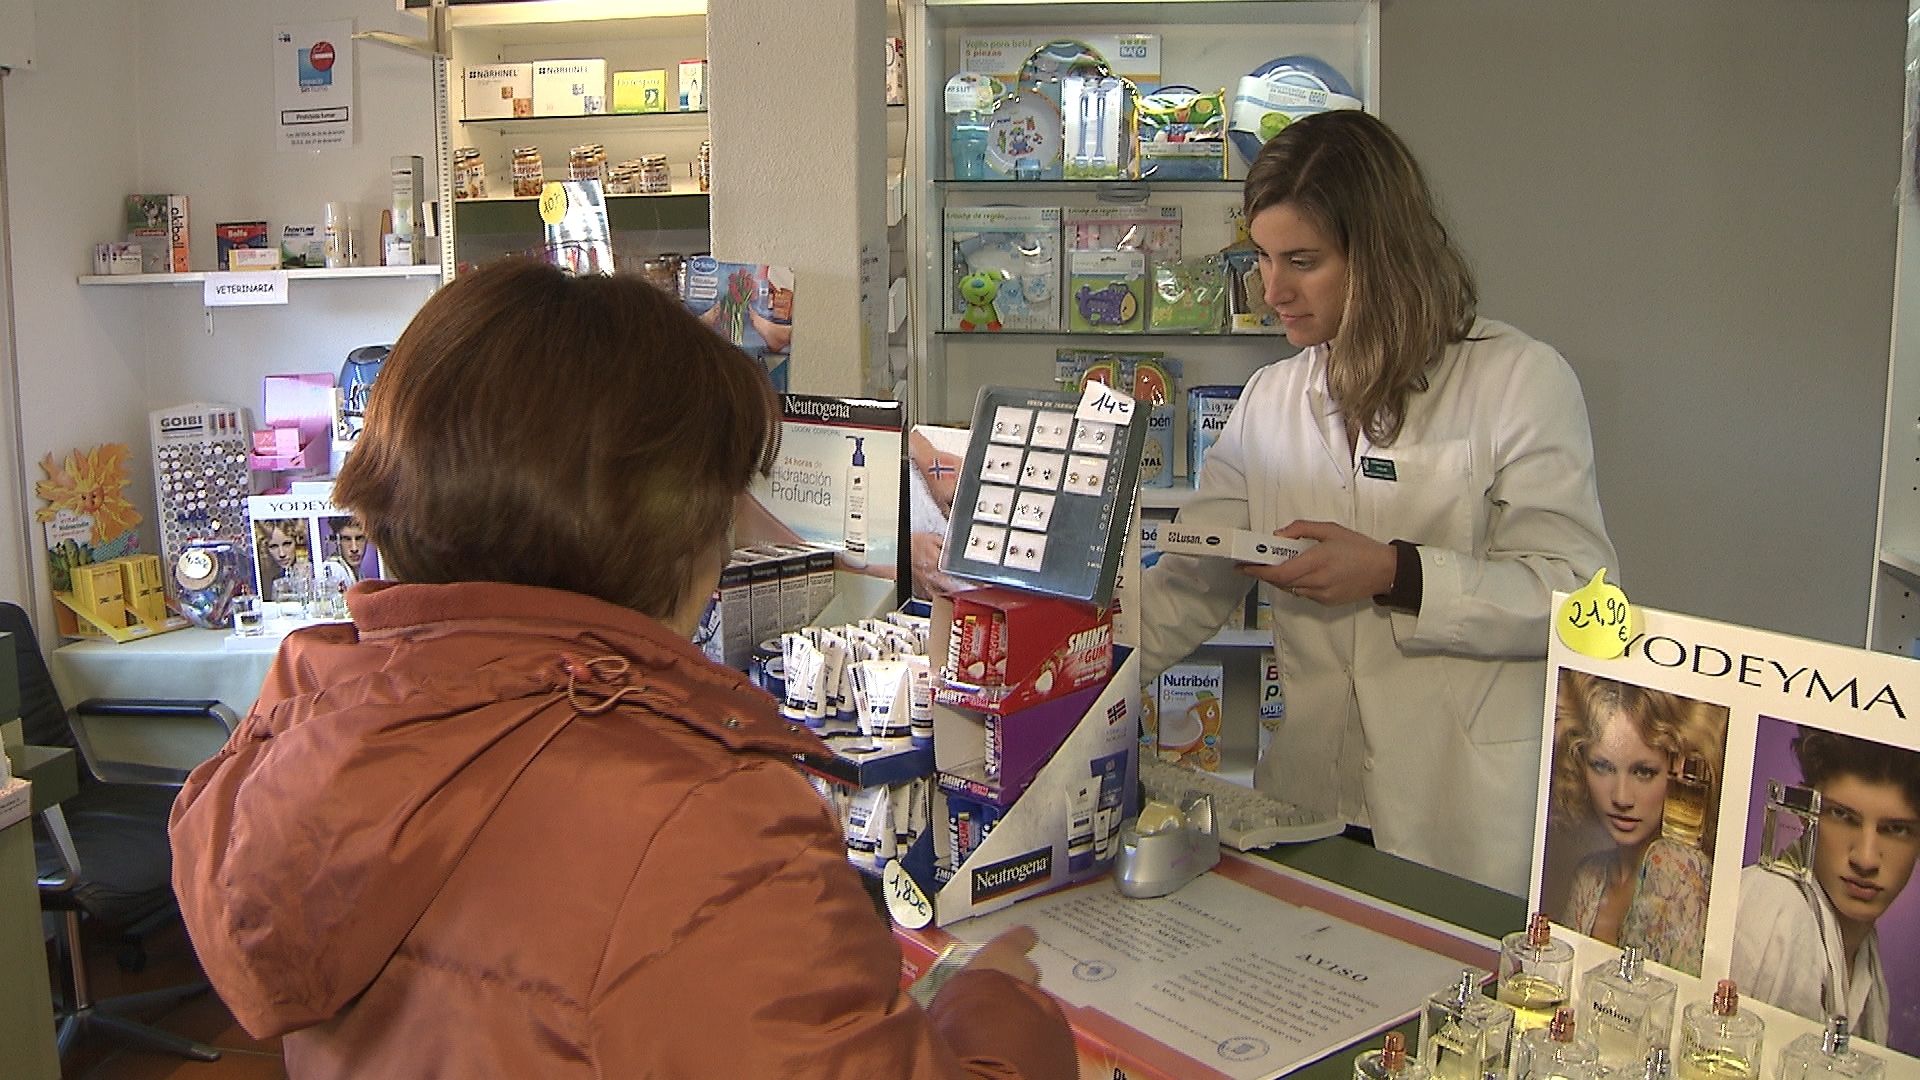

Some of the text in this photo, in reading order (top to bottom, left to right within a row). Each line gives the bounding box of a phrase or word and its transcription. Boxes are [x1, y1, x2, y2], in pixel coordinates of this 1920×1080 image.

[216, 283, 274, 295] VETERINARIA
[784, 394, 851, 421] Neutrogena
[160, 415, 203, 428] GOIBI
[771, 465, 832, 487] Hidratación
[771, 481, 832, 507] Profunda
[1568, 598, 1627, 629] 21,90
[1067, 624, 1110, 656] SMINT
[1618, 625, 1629, 643] €
[1164, 674, 1220, 688] Nutribén
[1623, 633, 1907, 720] YODEYMA
[975, 857, 1048, 891] Neutrogena
[1295, 953, 1369, 984] AVISO
